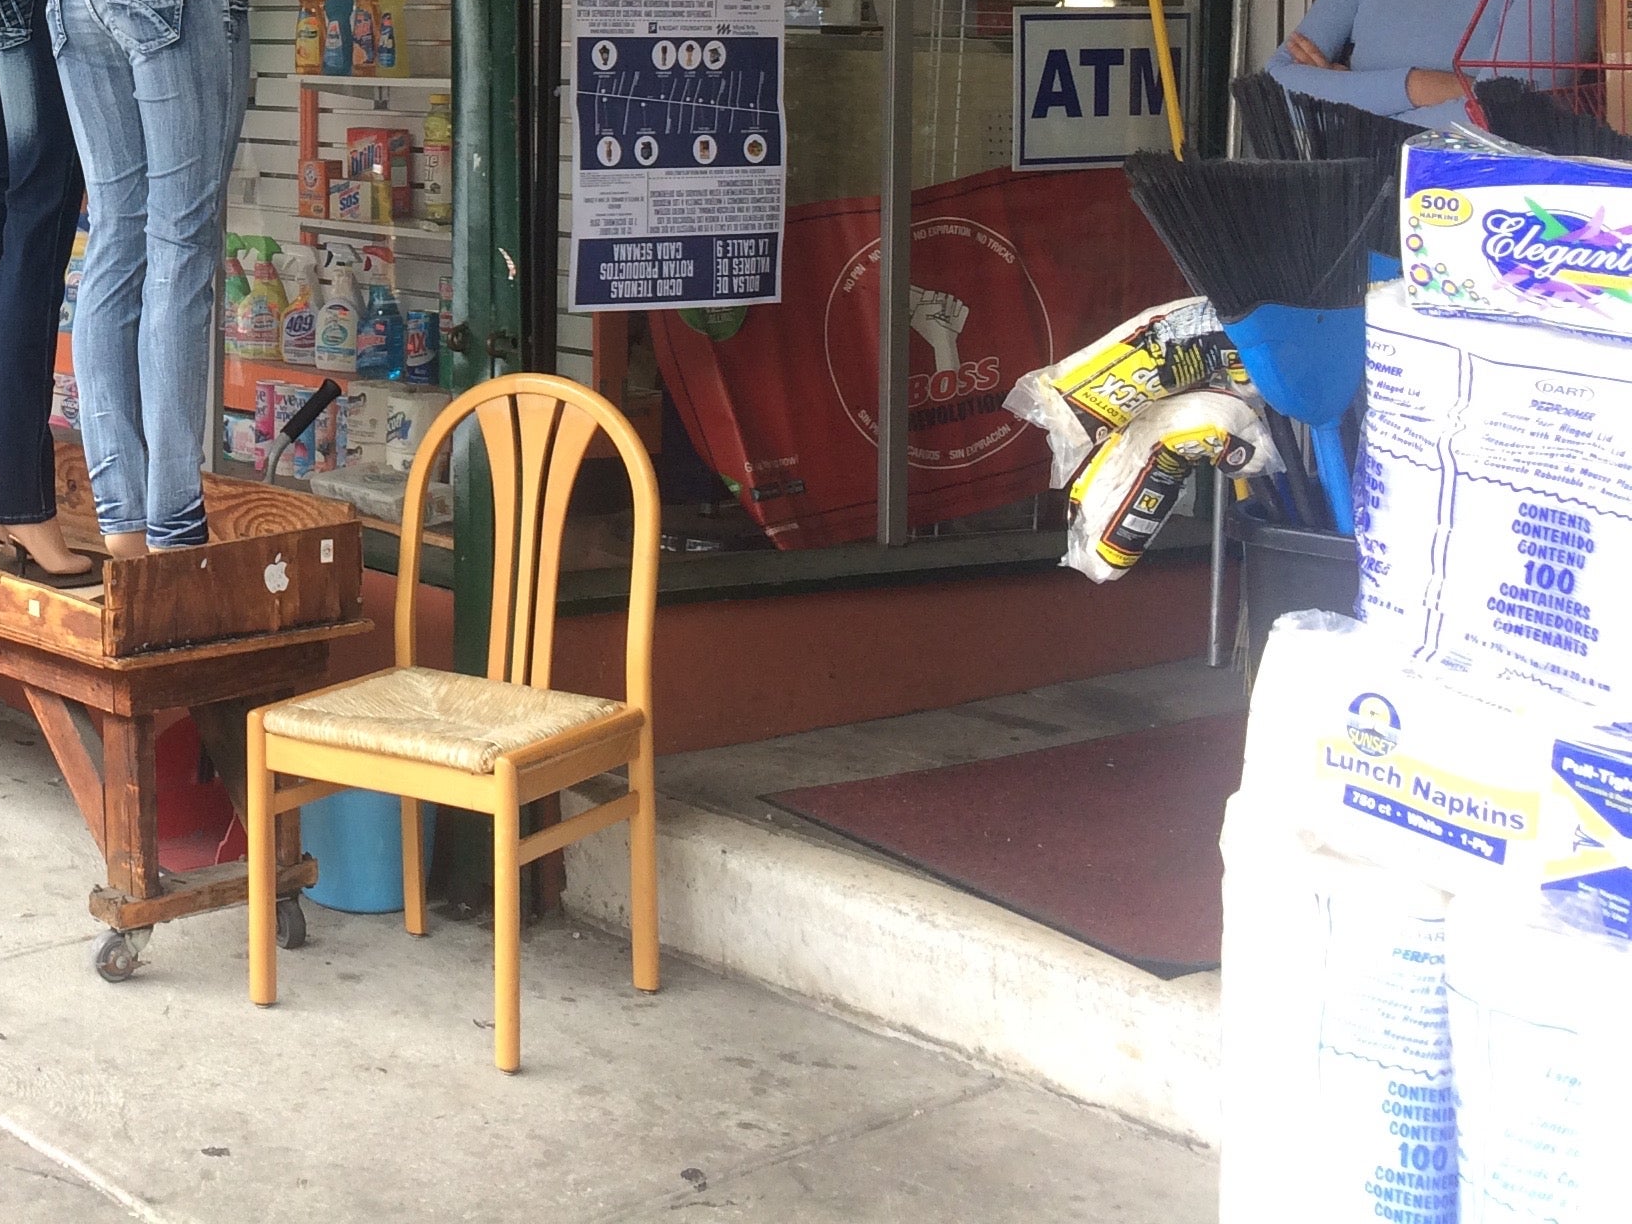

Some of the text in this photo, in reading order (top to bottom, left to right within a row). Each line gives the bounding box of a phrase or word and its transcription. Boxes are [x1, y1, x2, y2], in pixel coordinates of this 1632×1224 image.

[1031, 47, 1182, 120] ATM
[1421, 194, 1460, 212] 500
[1419, 212, 1460, 222] NAPKINS
[726, 238, 755, 257] CALLE
[758, 238, 769, 256] LA
[913, 231, 928, 241] NO
[975, 232, 1016, 265] NO TRICKS
[613, 242, 683, 262] CADA SEMANA
[599, 260, 694, 281] ROTAN PRODUCTOS
[716, 256, 770, 276] VALORES DE
[843, 263, 867, 293] NO PIN
[610, 278, 683, 299] OCHO TIENDAS
[716, 275, 761, 295] BOLSA DE
[285, 315, 313, 333] 409
[908, 356, 1000, 409] BOSS
[1542, 382, 1589, 399] DART
[1518, 501, 1593, 535] CONTENTS
[1510, 518, 1596, 554] CONTENIDO
[1517, 539, 1587, 570] CONTENU
[1523, 559, 1576, 596] 100
[1393, 605, 1405, 616] cm
[1499, 581, 1592, 622] CONTAINERS
[1486, 596, 1600, 643] CONTENEDORES
[1492, 617, 1589, 658] CONTENANTS
[1347, 726, 1396, 756] SUNSET
[1324, 745, 1402, 789] Lunch
[1411, 776, 1526, 832] Napkins
[1376, 798, 1393, 818] ct
[1397, 1141, 1449, 1172] 100
